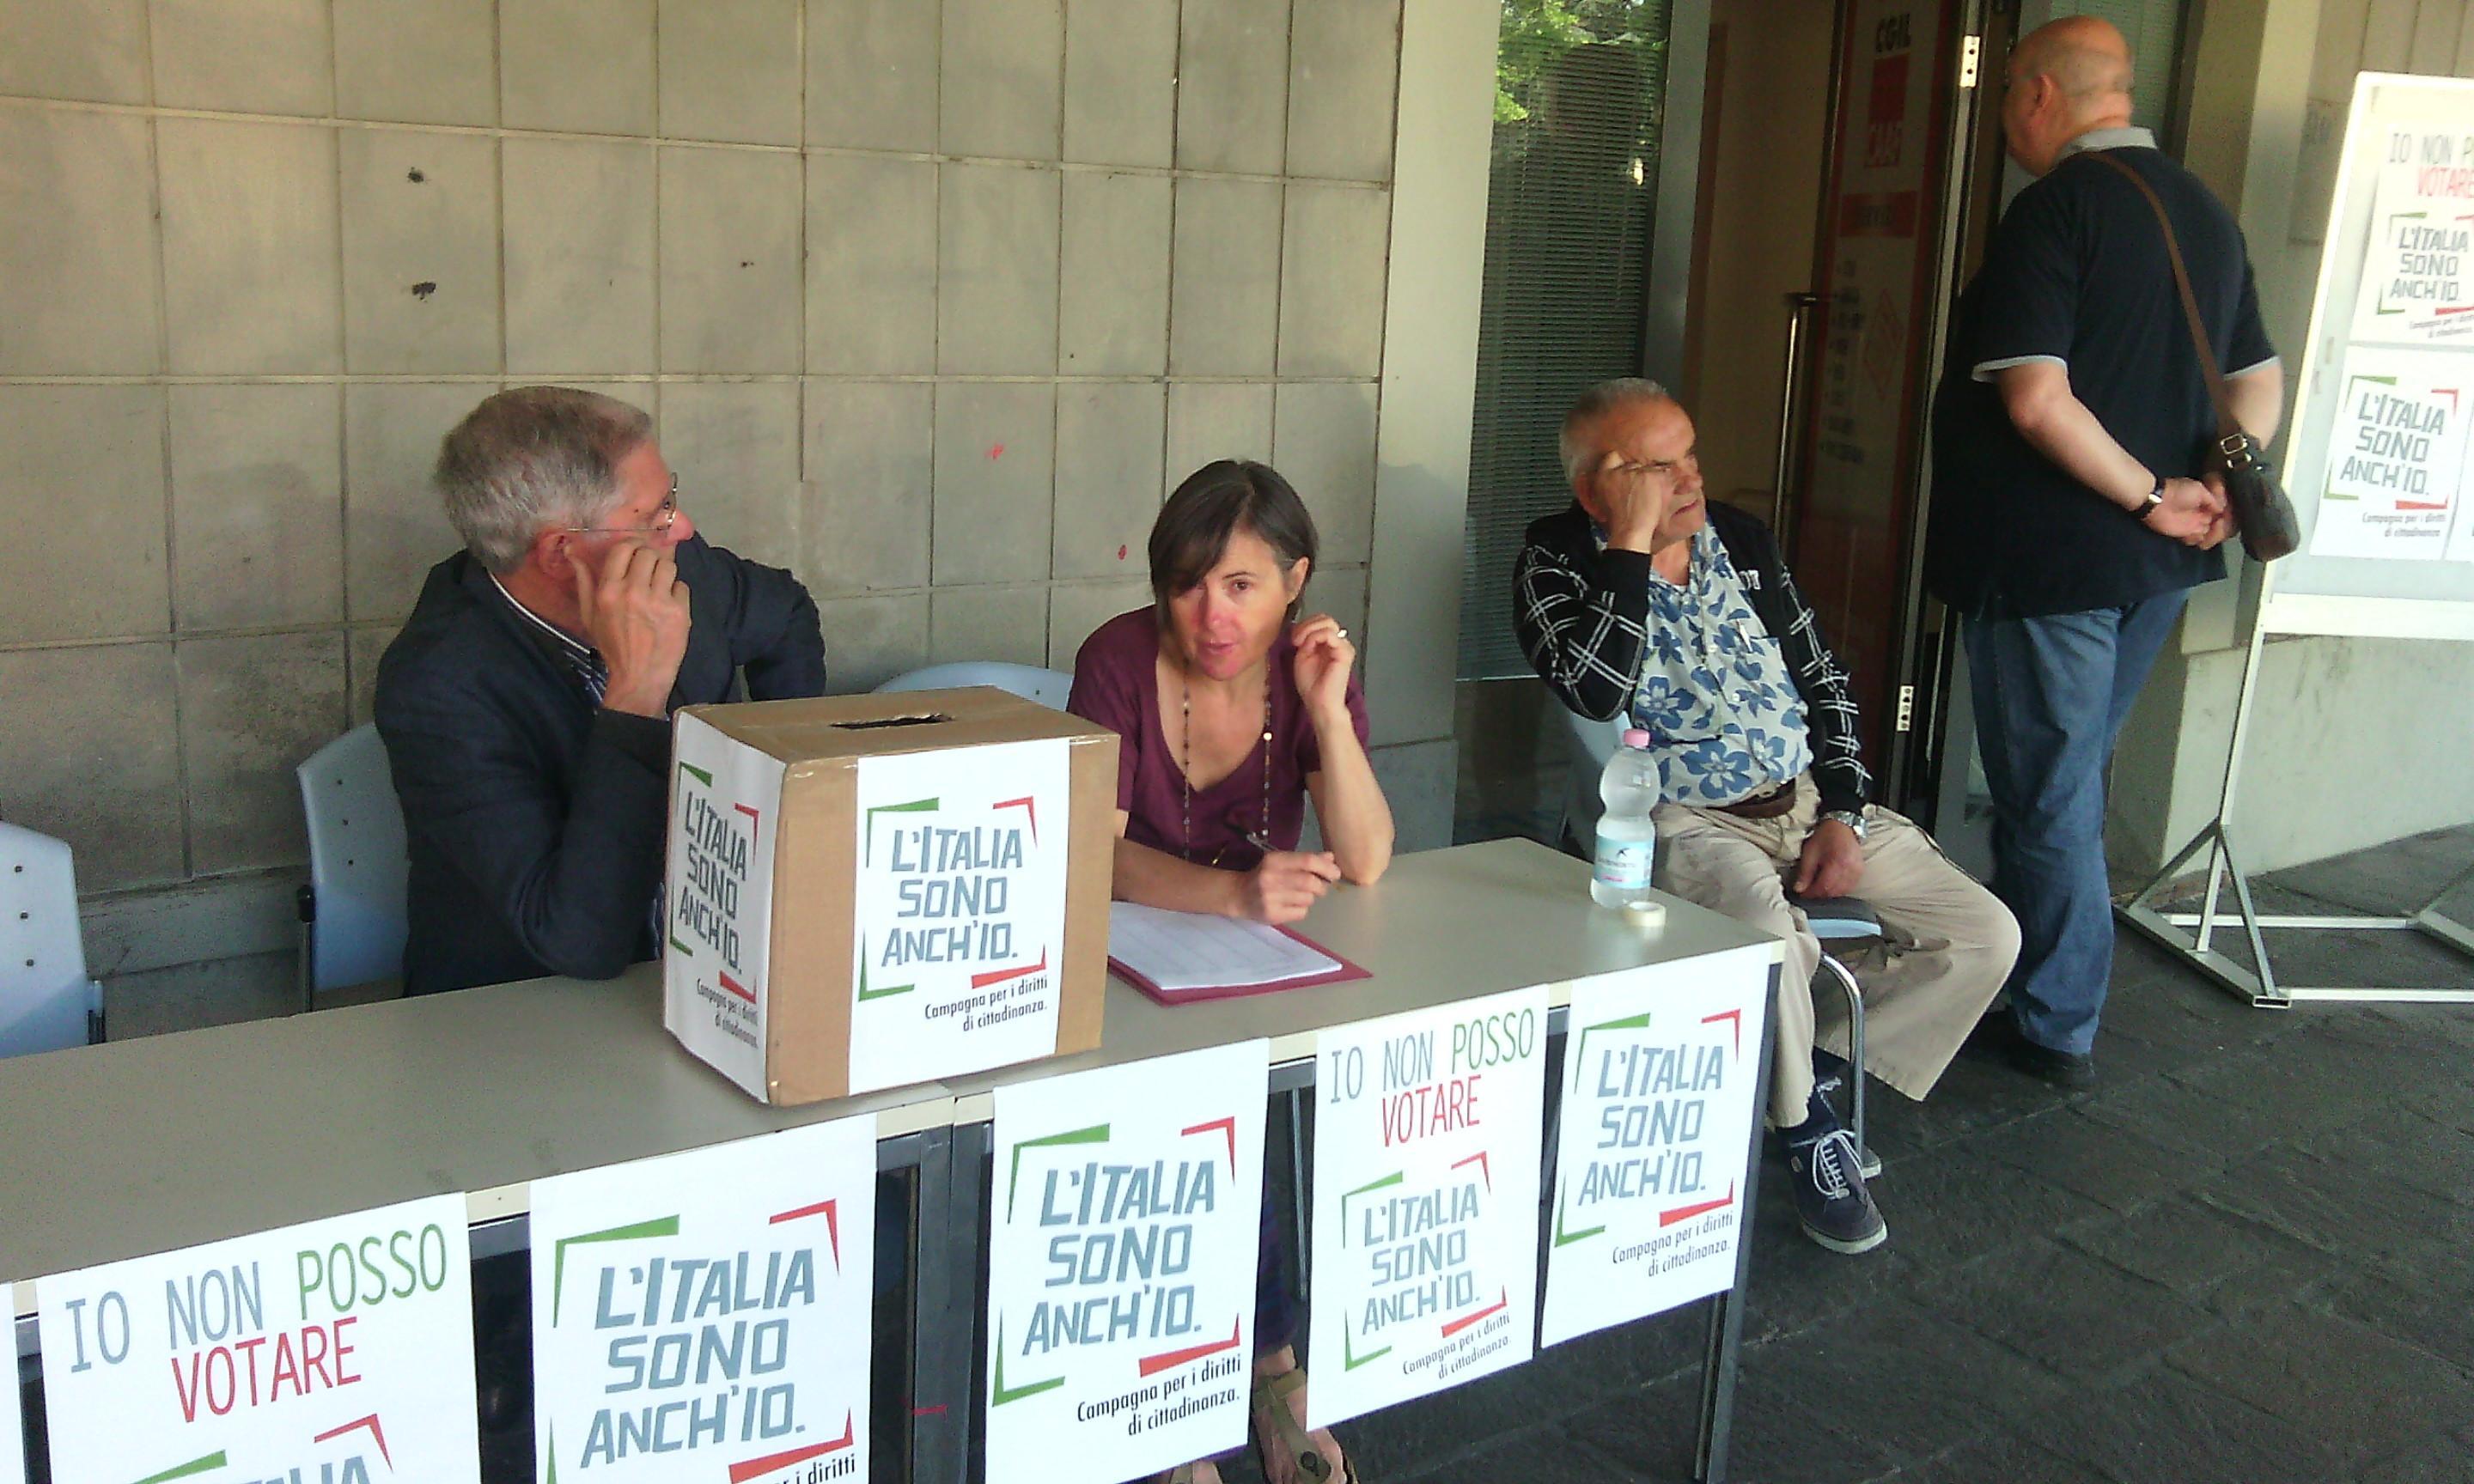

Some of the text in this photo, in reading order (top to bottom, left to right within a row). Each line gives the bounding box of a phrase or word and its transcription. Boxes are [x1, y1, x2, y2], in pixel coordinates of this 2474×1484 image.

[2390, 133, 2411, 163] IO
[2398, 227, 2469, 252] L'ITALIA
[2400, 253, 2459, 277] SONO
[2358, 392, 2445, 435] L'ITALIA
[2355, 426, 2429, 462] SONO
[2340, 456, 2429, 495] ANCH'IO.
[686, 791, 746, 880] L'ITALIA
[891, 826, 1022, 873] L'ITALIA
[687, 842, 737, 920] SONO
[898, 876, 1007, 918] SONO
[679, 886, 741, 974] ANCH'IO.
[881, 920, 1018, 967] ANCH'IO.
[925, 994, 985, 1019] Campagna
[990, 988, 1008, 1007] per
[1019, 975, 1048, 996] diritti
[963, 1000, 1047, 1032] di cittadinanza.
[1331, 1007, 1534, 1104] IO NON POSSO
[1597, 1044, 1724, 1098] L'ITALIA
[1381, 1074, 1482, 1147] VOTARE
[1597, 1099, 1704, 1149] SONO
[1039, 1160, 1216, 1226] L'ITALIA
[1578, 1149, 1707, 1206] ANCH'IO.
[1364, 1183, 1479, 1248] L'ITALIA
[1612, 1234, 1672, 1264] Campagna
[1676, 1226, 1692, 1247] per
[1703, 1210, 1733, 1233] diritti
[1045, 1224, 1192, 1288] SONO
[1372, 1229, 1466, 1287] SONO
[1648, 1239, 1731, 1277] di cittadinanza.
[65, 1224, 447, 1373] IO NON POSSO
[595, 1249, 815, 1329] L'ITALIA
[1362, 1270, 1480, 1336] ANCH'IO.
[1022, 1284, 1202, 1356] ANCH'IO.
[1403, 1342, 1456, 1375] Campagna
[1459, 1333, 1474, 1352] per
[1484, 1312, 1510, 1335] diritti
[171, 1317, 362, 1423] VOTARE
[605, 1319, 789, 1394] SONO
[1438, 1363, 1448, 1379] di
[1077, 1384, 1158, 1422] Campagna
[1164, 1374, 1187, 1400] per
[1201, 1353, 1240, 1383] diritti
[1128, 1387, 1240, 1436] di cittadinanza.
[580, 1383, 807, 1469] ANCH'IO.
[807, 1453, 856, 1484] diritti
